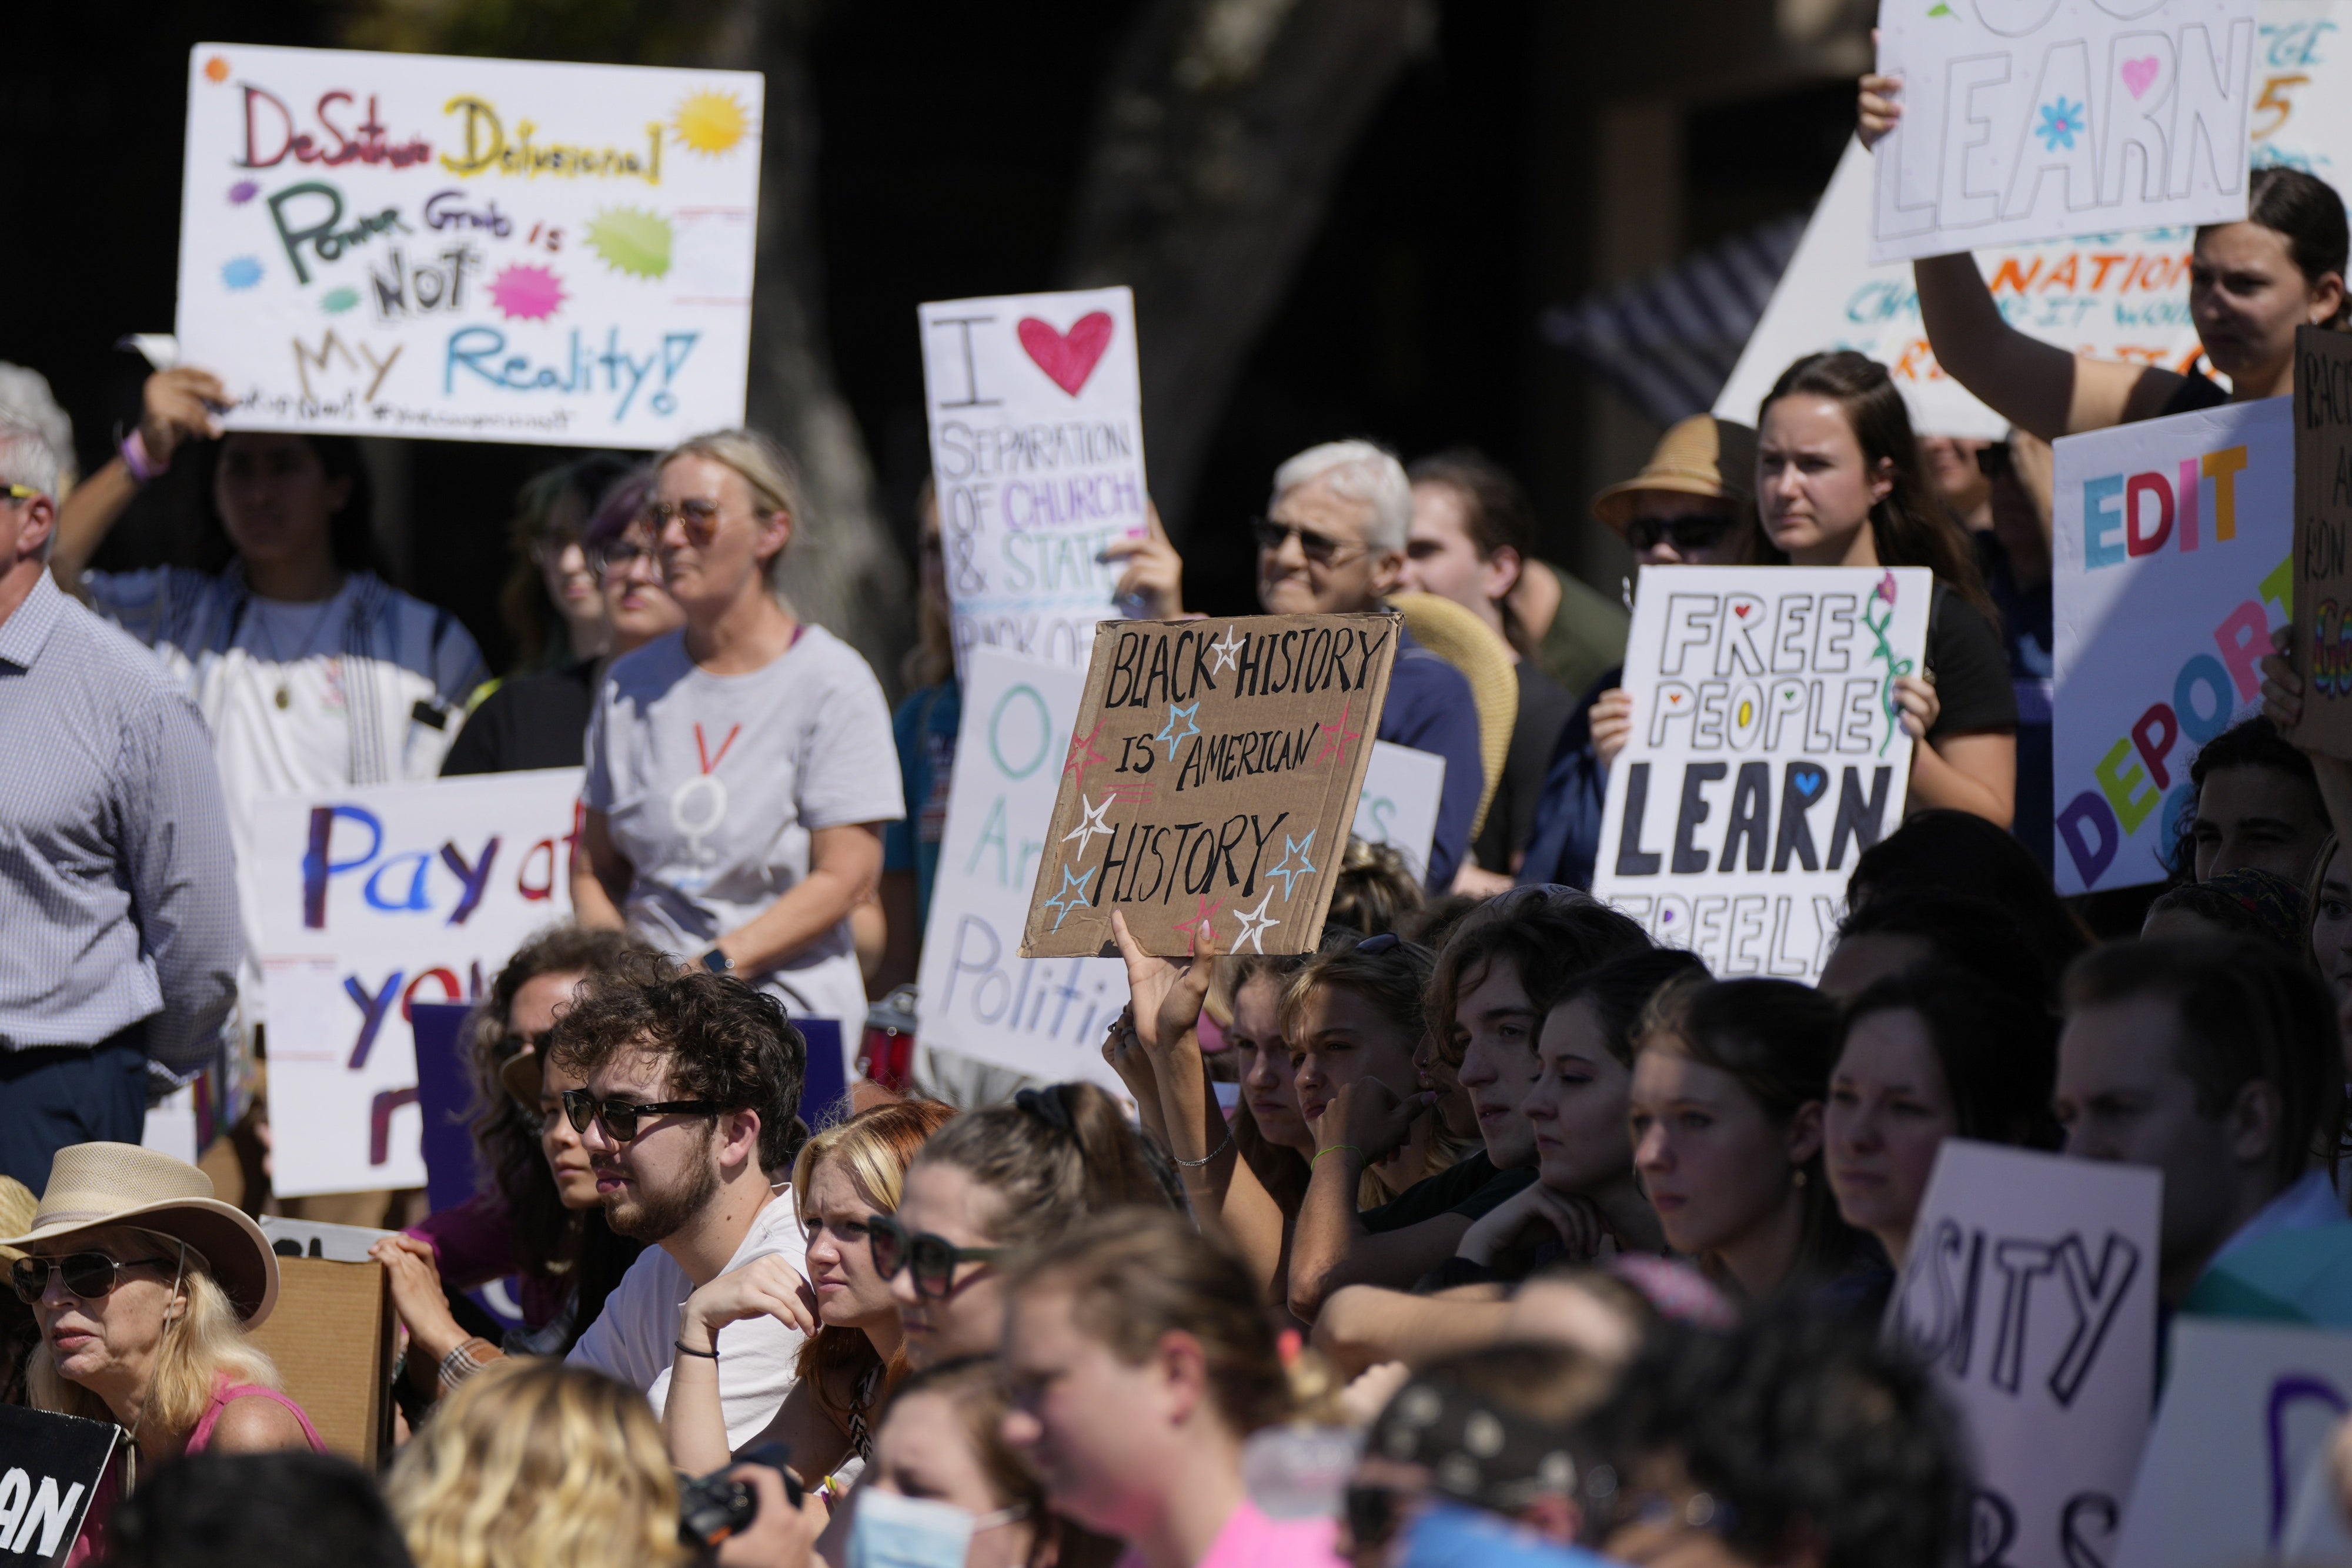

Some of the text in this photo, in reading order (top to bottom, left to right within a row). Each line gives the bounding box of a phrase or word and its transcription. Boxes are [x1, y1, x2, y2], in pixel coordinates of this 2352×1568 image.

[1876, 18, 2257, 242] LEARN
[369, 236, 481, 330] NOT
[932, 315, 1004, 409] I
[941, 420, 1131, 481] SEPARATION
[945, 473, 1142, 536] OF CHURCH
[2084, 445, 2247, 571] EDIT
[1104, 627, 1389, 708] BLACK HISTORY
[1659, 593, 1858, 677] FREE
[1115, 722, 1321, 791] IS AMERICAN
[1648, 677, 1878, 755] PEOPLE
[302, 801, 502, 931] Pay
[1091, 812, 1290, 907] HISTORY
[1615, 762, 1892, 877] LEARN
